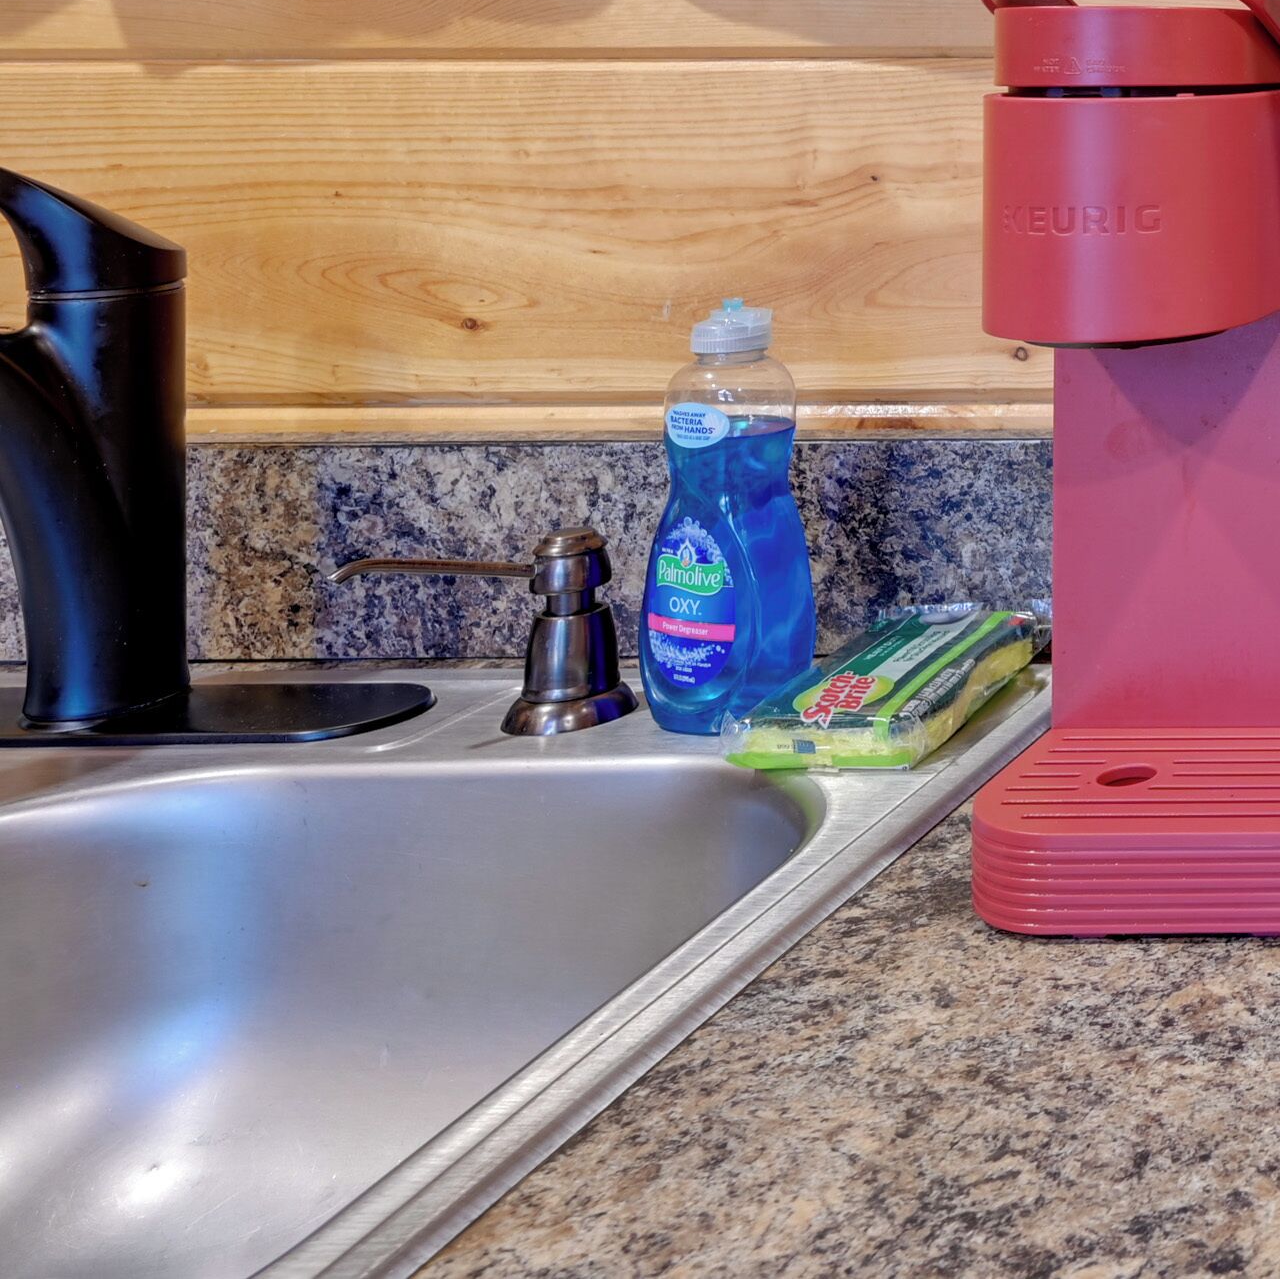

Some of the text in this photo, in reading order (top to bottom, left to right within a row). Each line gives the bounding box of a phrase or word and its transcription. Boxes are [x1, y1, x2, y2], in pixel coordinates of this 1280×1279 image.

[1002, 204, 1162, 236] KEURIG
[670, 415, 703, 426] BACTERIA
[671, 423, 714, 435] FROM HANDS
[657, 559, 722, 588] Palmolive
[662, 621, 709, 636] Power Degreaser
[834, 675, 877, 712] Brite
